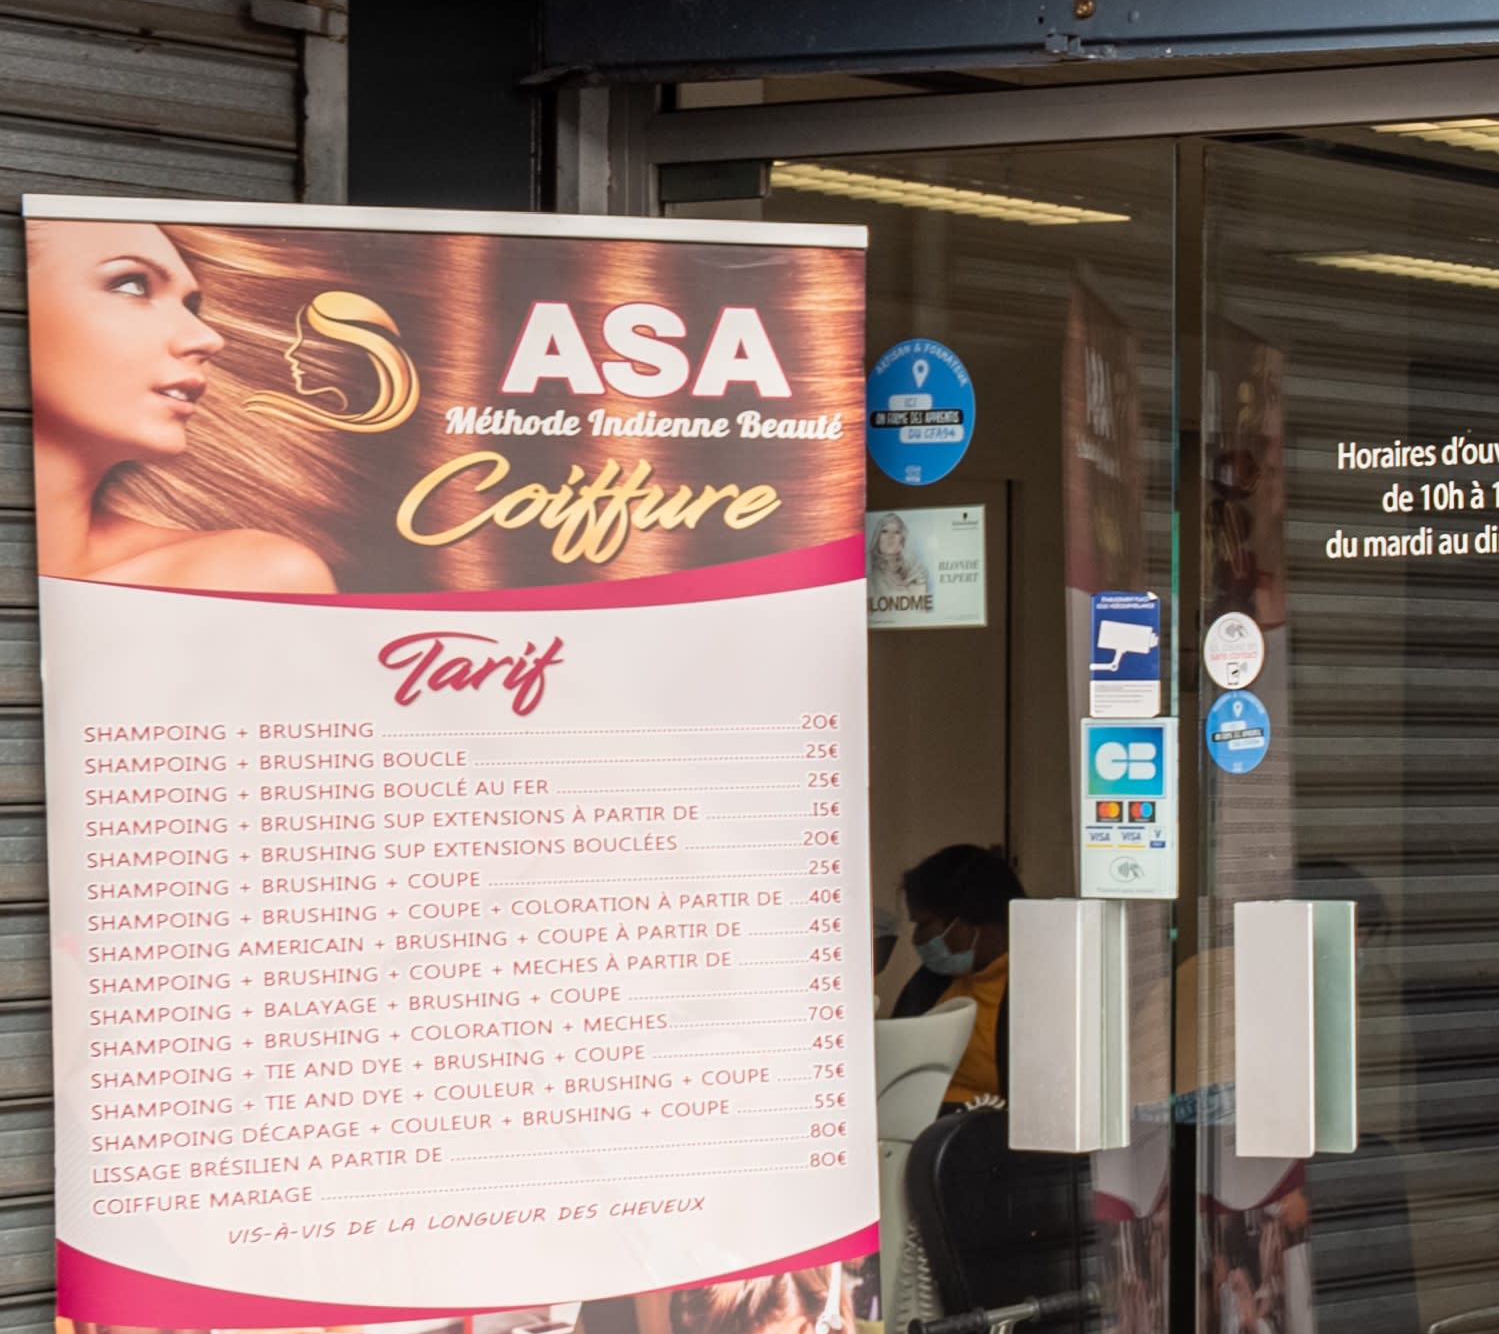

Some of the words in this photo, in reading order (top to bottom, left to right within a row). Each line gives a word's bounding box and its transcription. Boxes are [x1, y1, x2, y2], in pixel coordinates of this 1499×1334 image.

[501, 302, 793, 399] ASA
[445, 404, 582, 438] Méthode
[588, 406, 732, 439] Indienne
[739, 409, 845, 442] Beauté
[1338, 440, 1436, 470] Horaires
[396, 451, 783, 564] Coiffure
[1382, 484, 1413, 512] de
[1420, 480, 1464, 511] 10h
[1470, 481, 1484, 508] à
[1326, 530, 1357, 559] du
[1363, 527, 1432, 557] mardi
[1438, 532, 1468, 555] au
[869, 595, 933, 612] LONDME
[378, 631, 566, 717] Tarif
[83, 724, 227, 743] SHAMPOING
[237, 728, 249, 739] +
[259, 722, 375, 740] BRUSHING
[801, 714, 839, 731] 20€
[92, 1193, 200, 1216] COIFFURE
[210, 1186, 313, 1208] MARIAGE
[810, 1151, 847, 1168] 80€
[229, 1221, 336, 1245] VIS-À-VIS
[347, 1220, 377, 1236] DE
[388, 1217, 415, 1234] LA
[428, 1208, 546, 1232] LONGUEUR
[558, 1204, 598, 1222] DES
[609, 1196, 706, 1219] CHEVEUX
